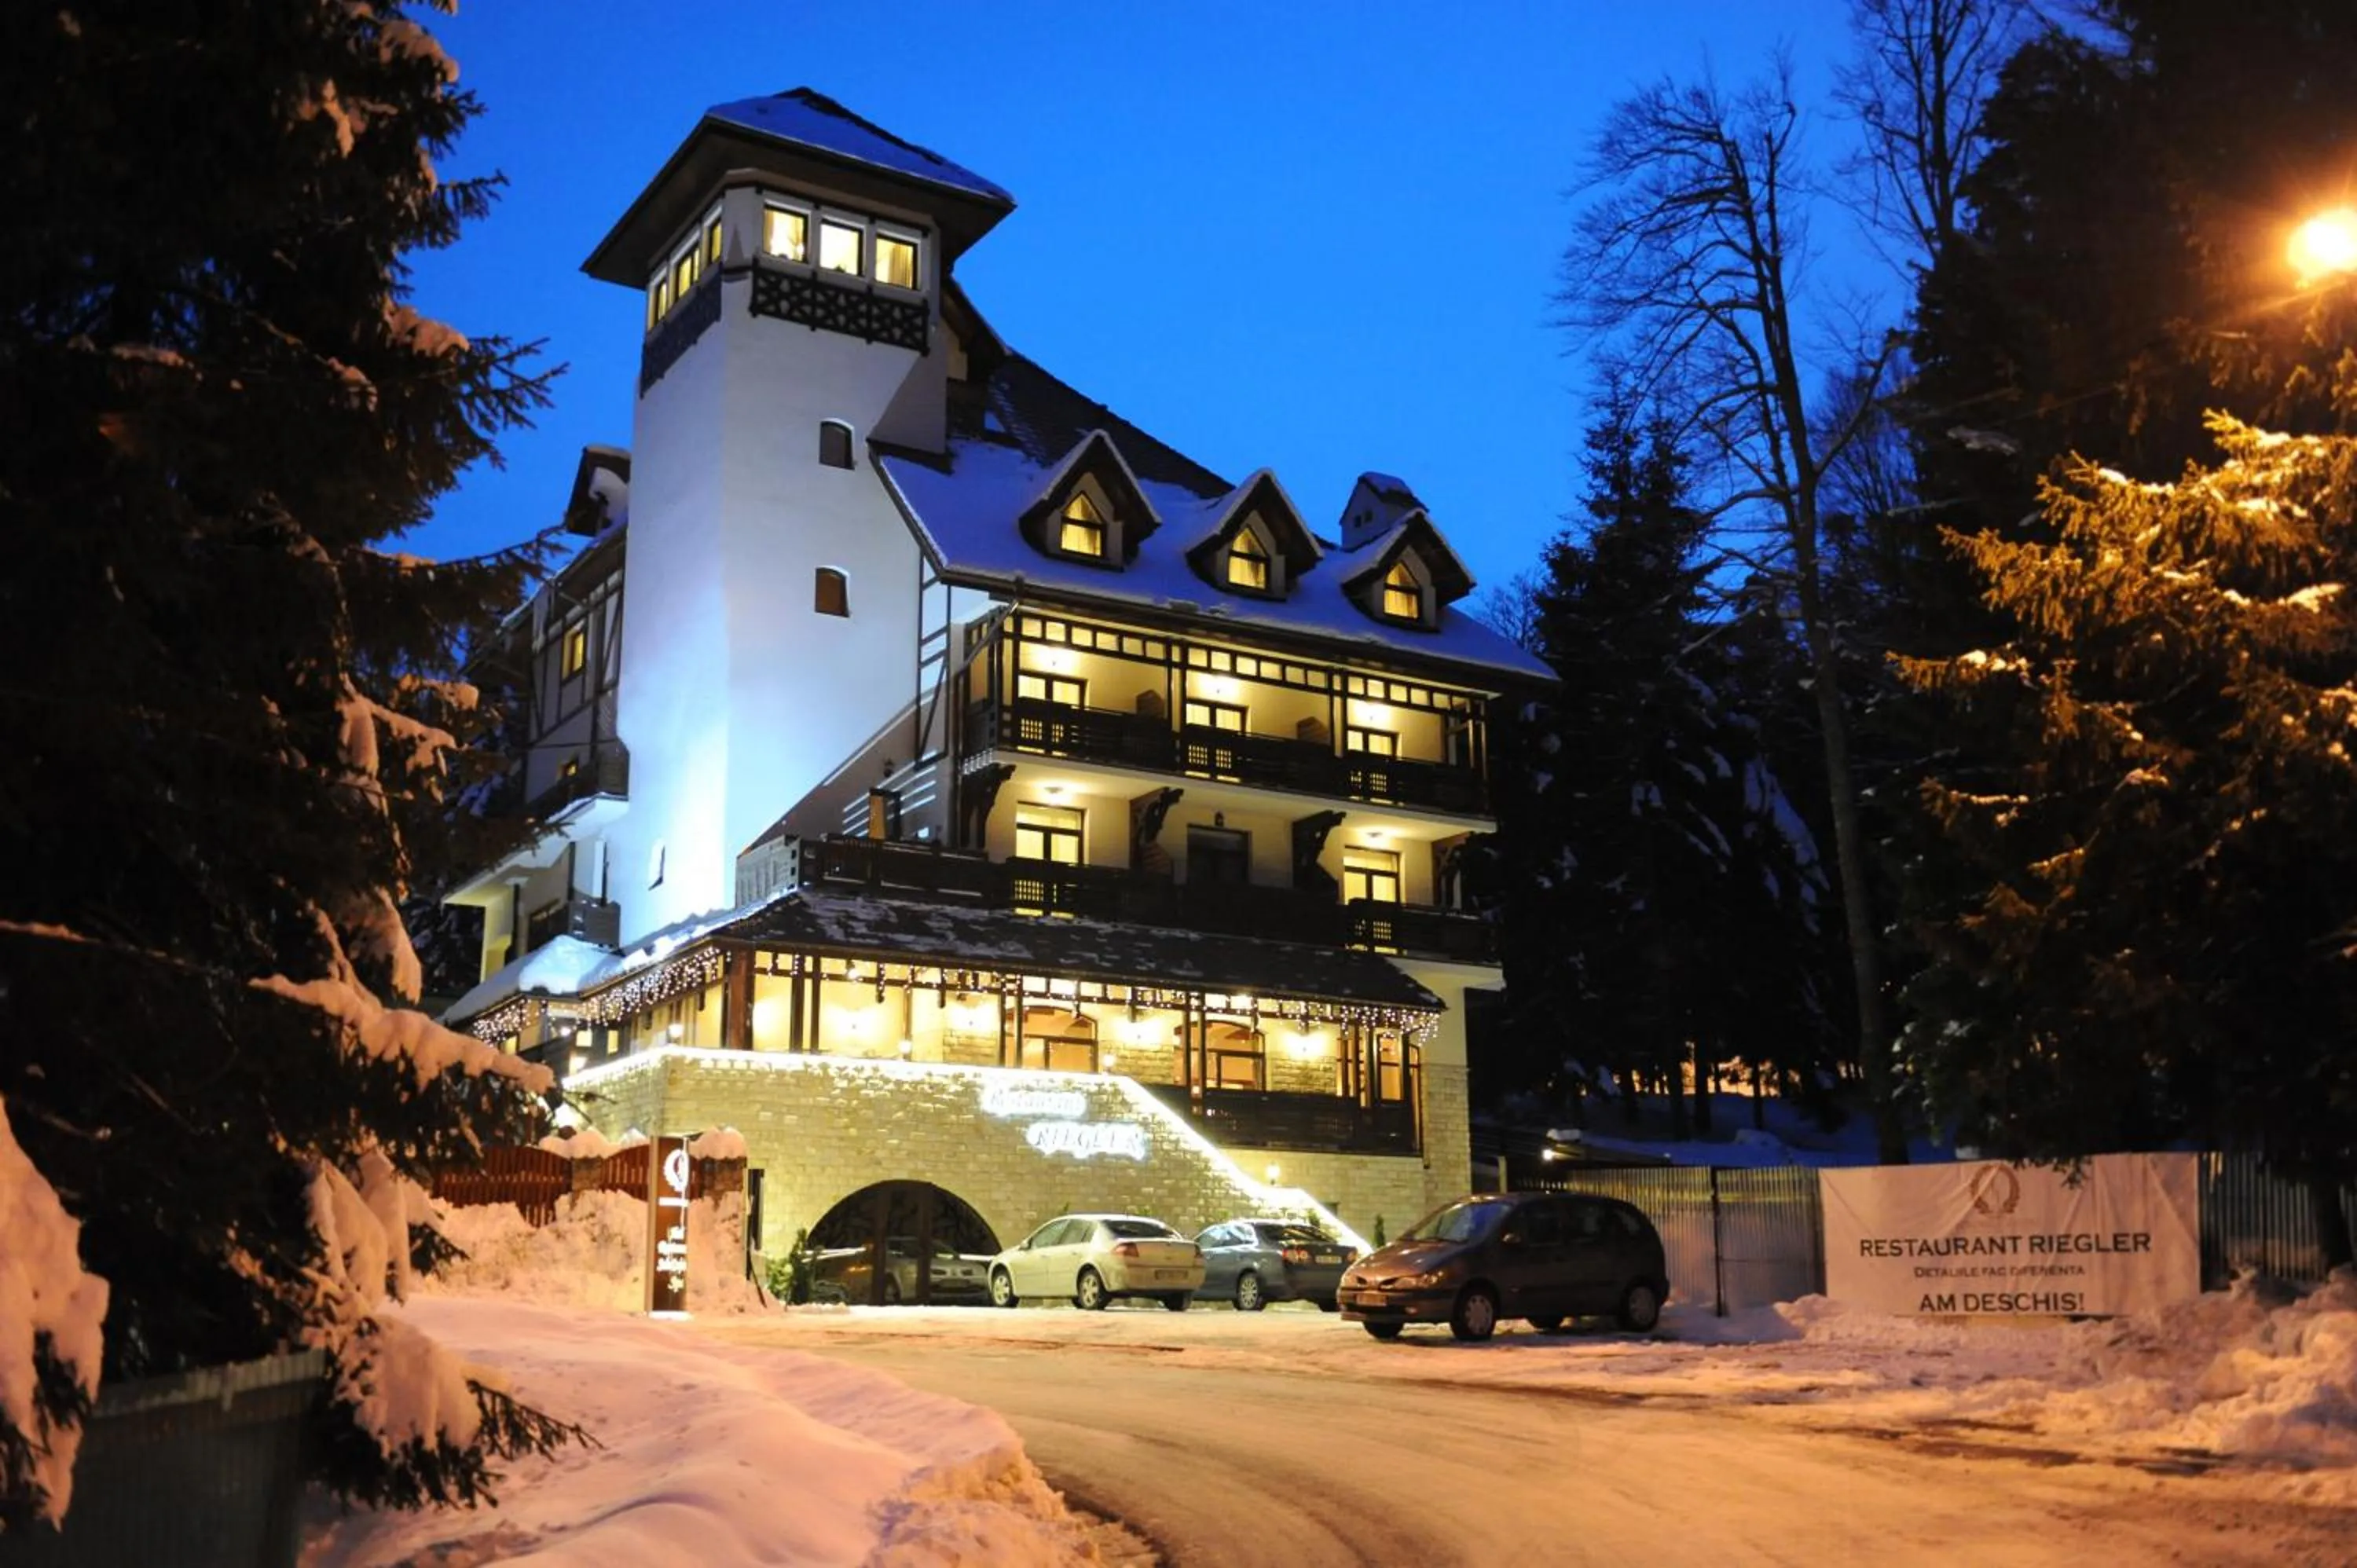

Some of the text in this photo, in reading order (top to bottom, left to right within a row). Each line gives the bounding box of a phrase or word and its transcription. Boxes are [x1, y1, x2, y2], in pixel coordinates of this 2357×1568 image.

[1860, 1233, 2151, 1257] RESTAURANT RIEGLER
[1982, 1265, 2007, 1278] FAC
[1919, 1292, 2085, 1313] AM DESCHIS!
